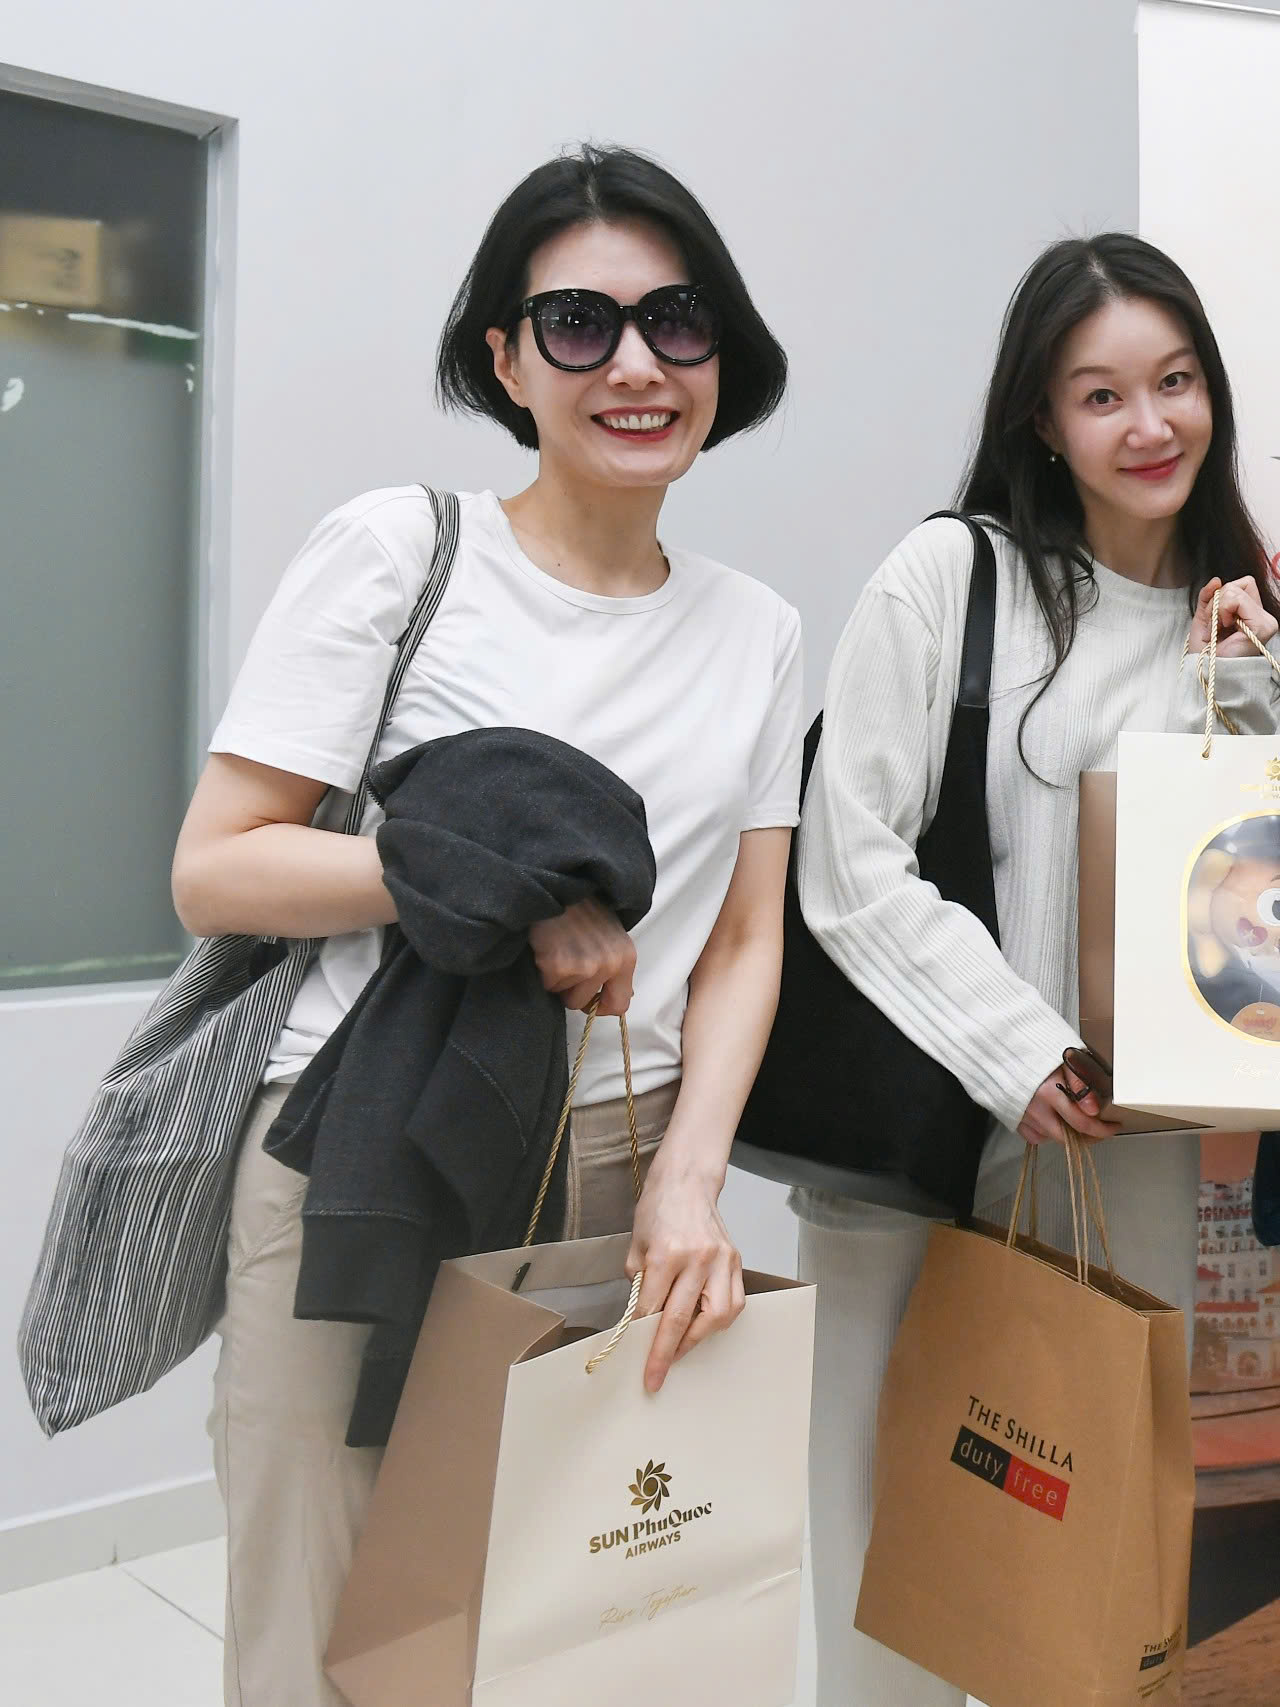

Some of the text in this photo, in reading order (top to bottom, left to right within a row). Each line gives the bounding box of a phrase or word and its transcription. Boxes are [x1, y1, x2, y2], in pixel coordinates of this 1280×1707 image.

[967, 1394, 1074, 1473] THE SHILLA
[960, 1437, 1059, 1507] duty free
[589, 1501, 713, 1554] SUN PhuQuoc
[625, 1530, 682, 1560] AIRWAYS
